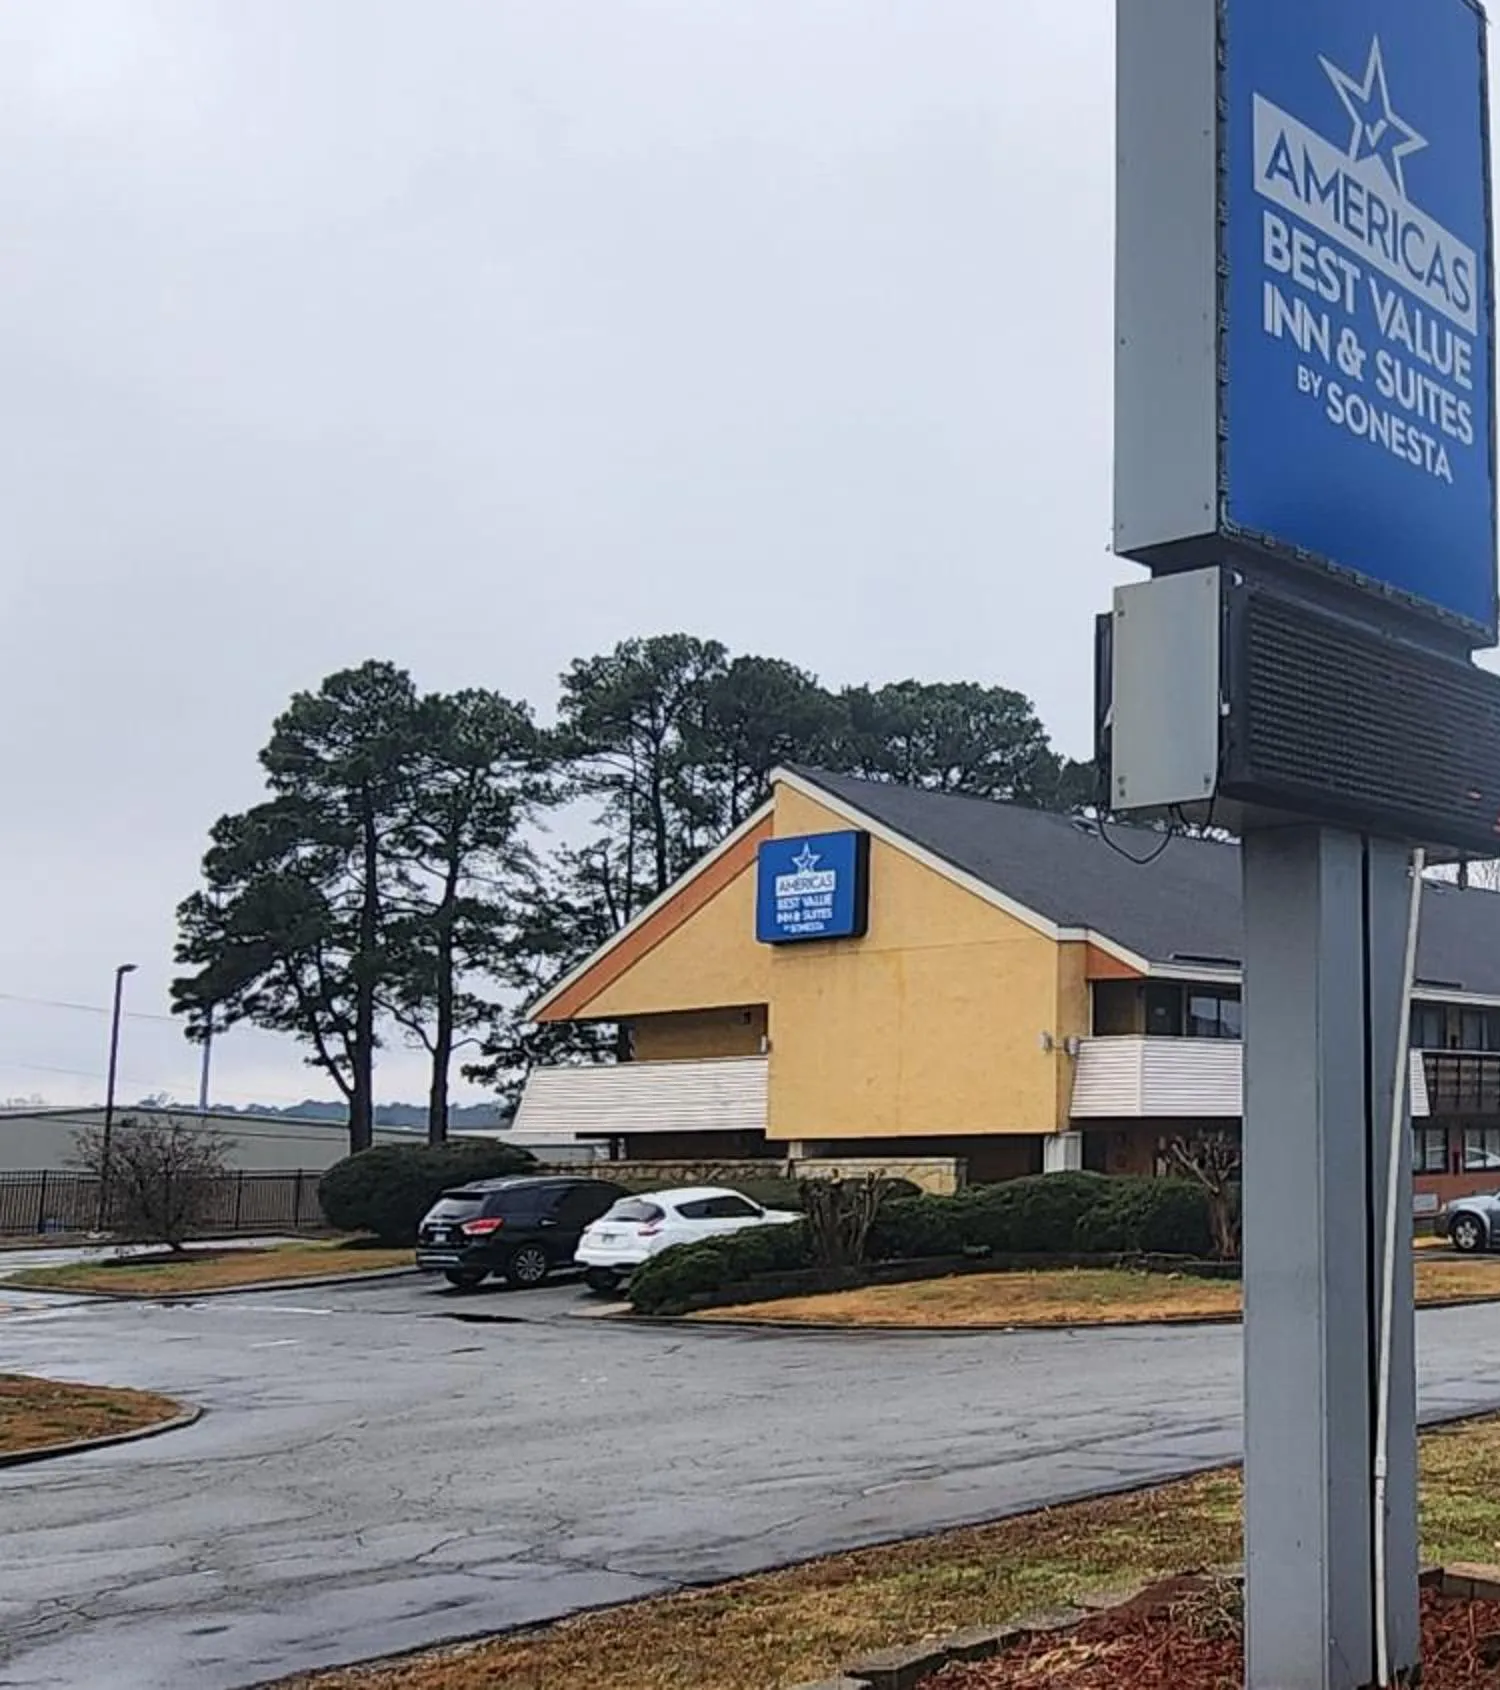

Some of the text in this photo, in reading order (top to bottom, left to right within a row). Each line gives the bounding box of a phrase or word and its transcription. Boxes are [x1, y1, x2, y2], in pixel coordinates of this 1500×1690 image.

[1263, 210, 1473, 390] BEST VALUE
[1265, 130, 1470, 313] AMERICAS
[1263, 281, 1473, 446] INN & SUITES
[1297, 364, 1453, 484] BY SONESTA
[780, 875, 833, 890] AMERICAS
